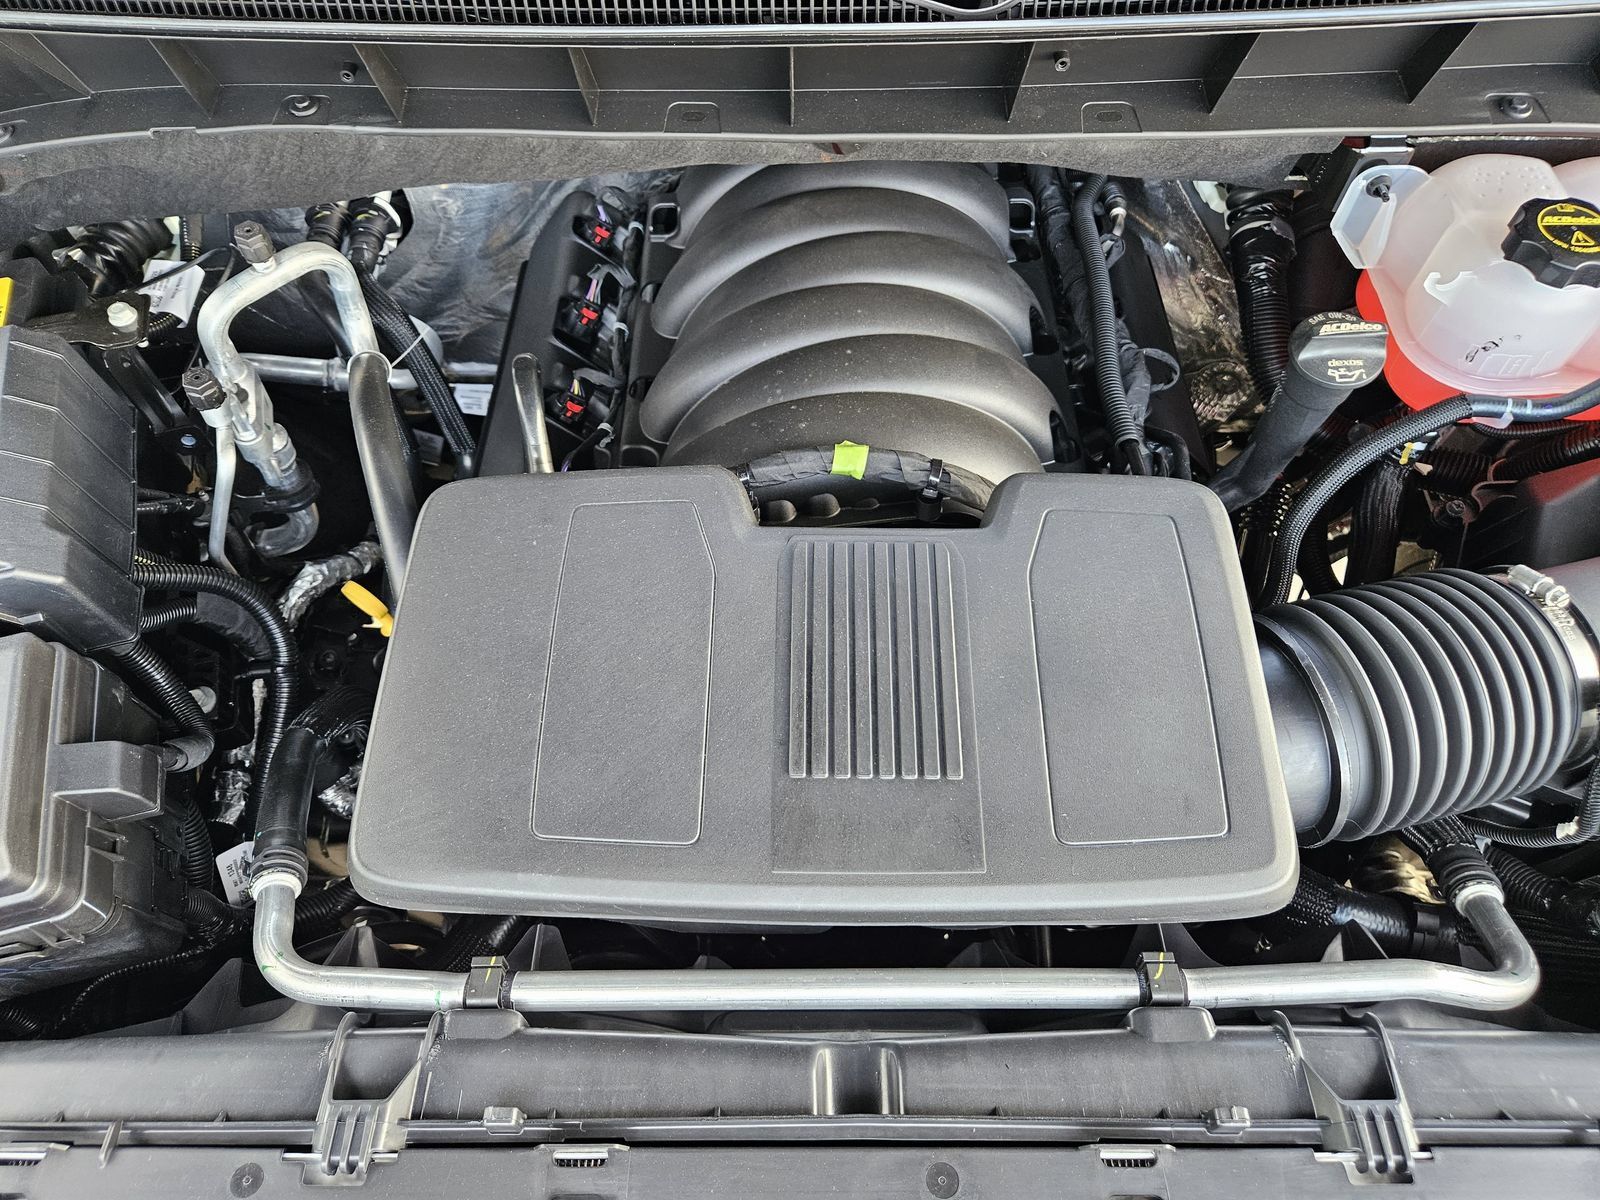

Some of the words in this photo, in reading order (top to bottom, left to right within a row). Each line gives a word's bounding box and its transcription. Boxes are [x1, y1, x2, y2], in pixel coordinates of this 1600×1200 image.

[1308, 314, 1326, 325] SAE
[1319, 322, 1383, 334] ACDelco
[1327, 359, 1364, 367] dexos
